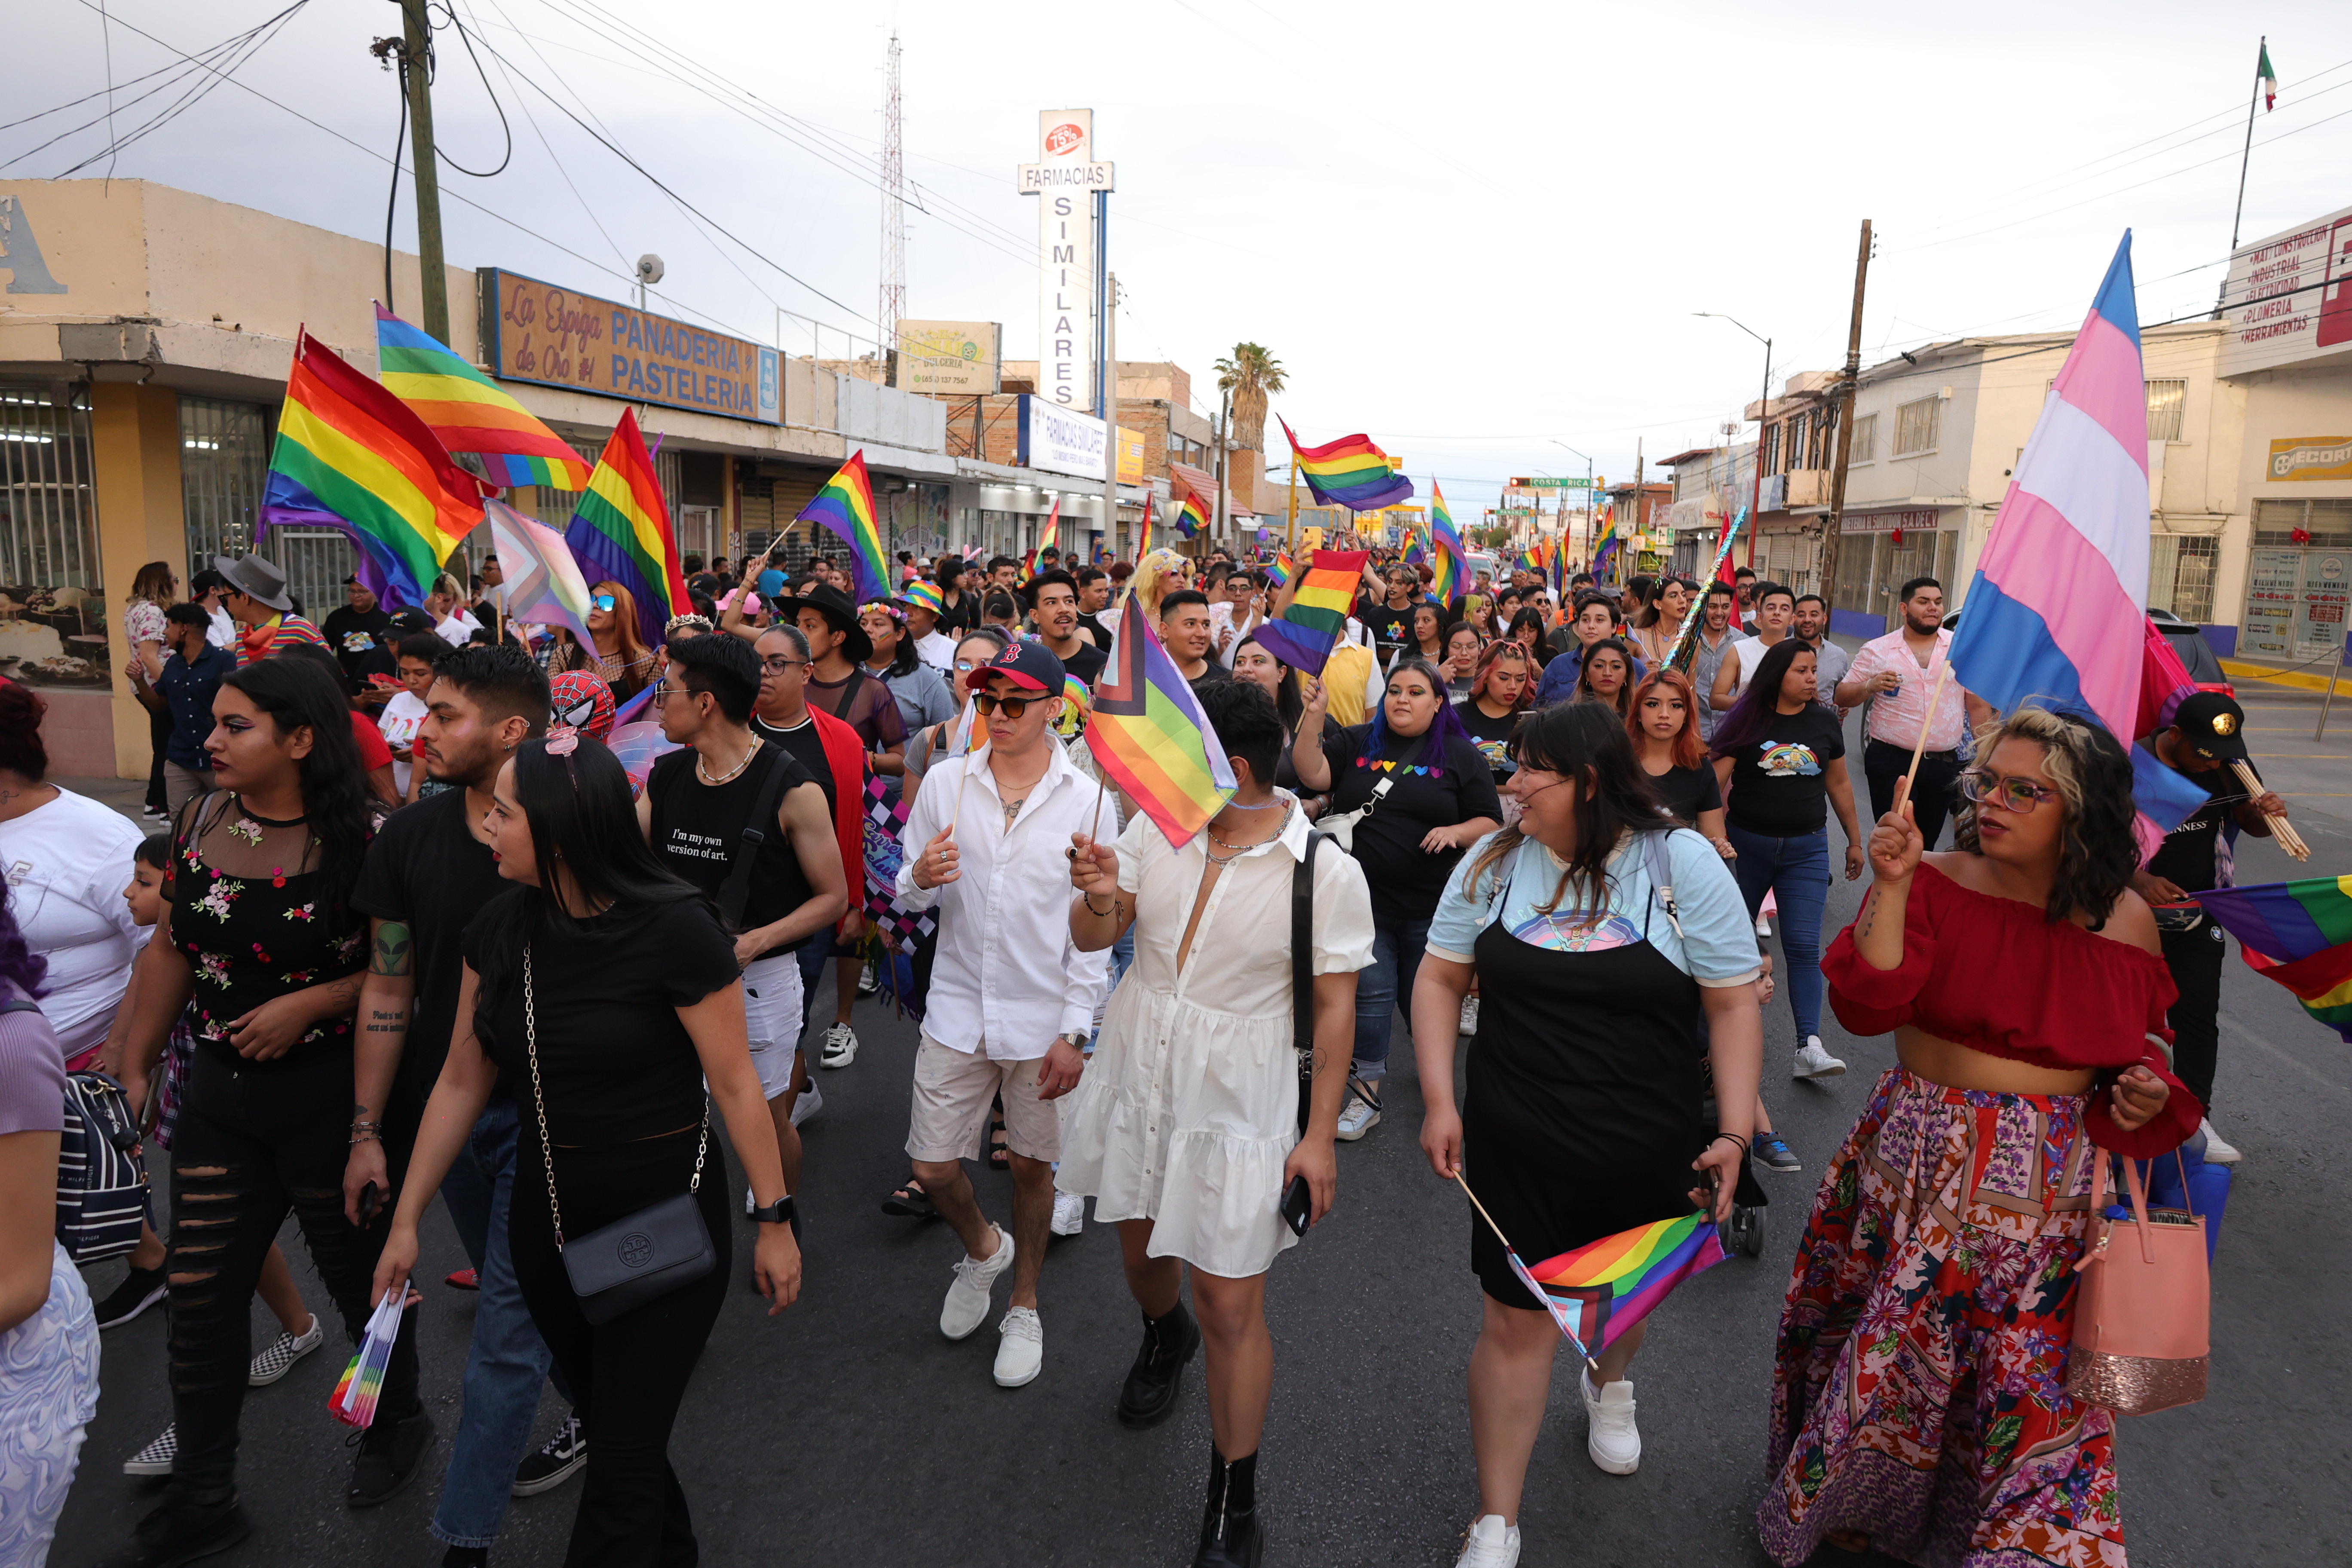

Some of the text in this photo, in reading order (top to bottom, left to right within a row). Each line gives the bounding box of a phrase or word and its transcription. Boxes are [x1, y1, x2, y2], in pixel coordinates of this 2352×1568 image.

[1049, 128, 1077, 148] 75%
[1026, 166, 1104, 187] FARMACIAS
[2251, 254, 2300, 285] INDUSTRIAL
[1053, 197, 1074, 404] SIMILARES
[2246, 297, 2292, 324] PLOMERIA
[505, 284, 602, 353] La Espiga
[2244, 315, 2308, 344] HERRAMIENTAS
[516, 332, 536, 372] de
[543, 345, 570, 378] Oro
[612, 311, 740, 374] PANADERIA
[612, 354, 753, 413] PASTELERIA
[1047, 415, 1102, 455] FARMACIAS SIMILARES
[672, 829, 722, 846] I'm my own
[2170, 820, 2209, 834] INNESS
[667, 844, 728, 861] version of art.
